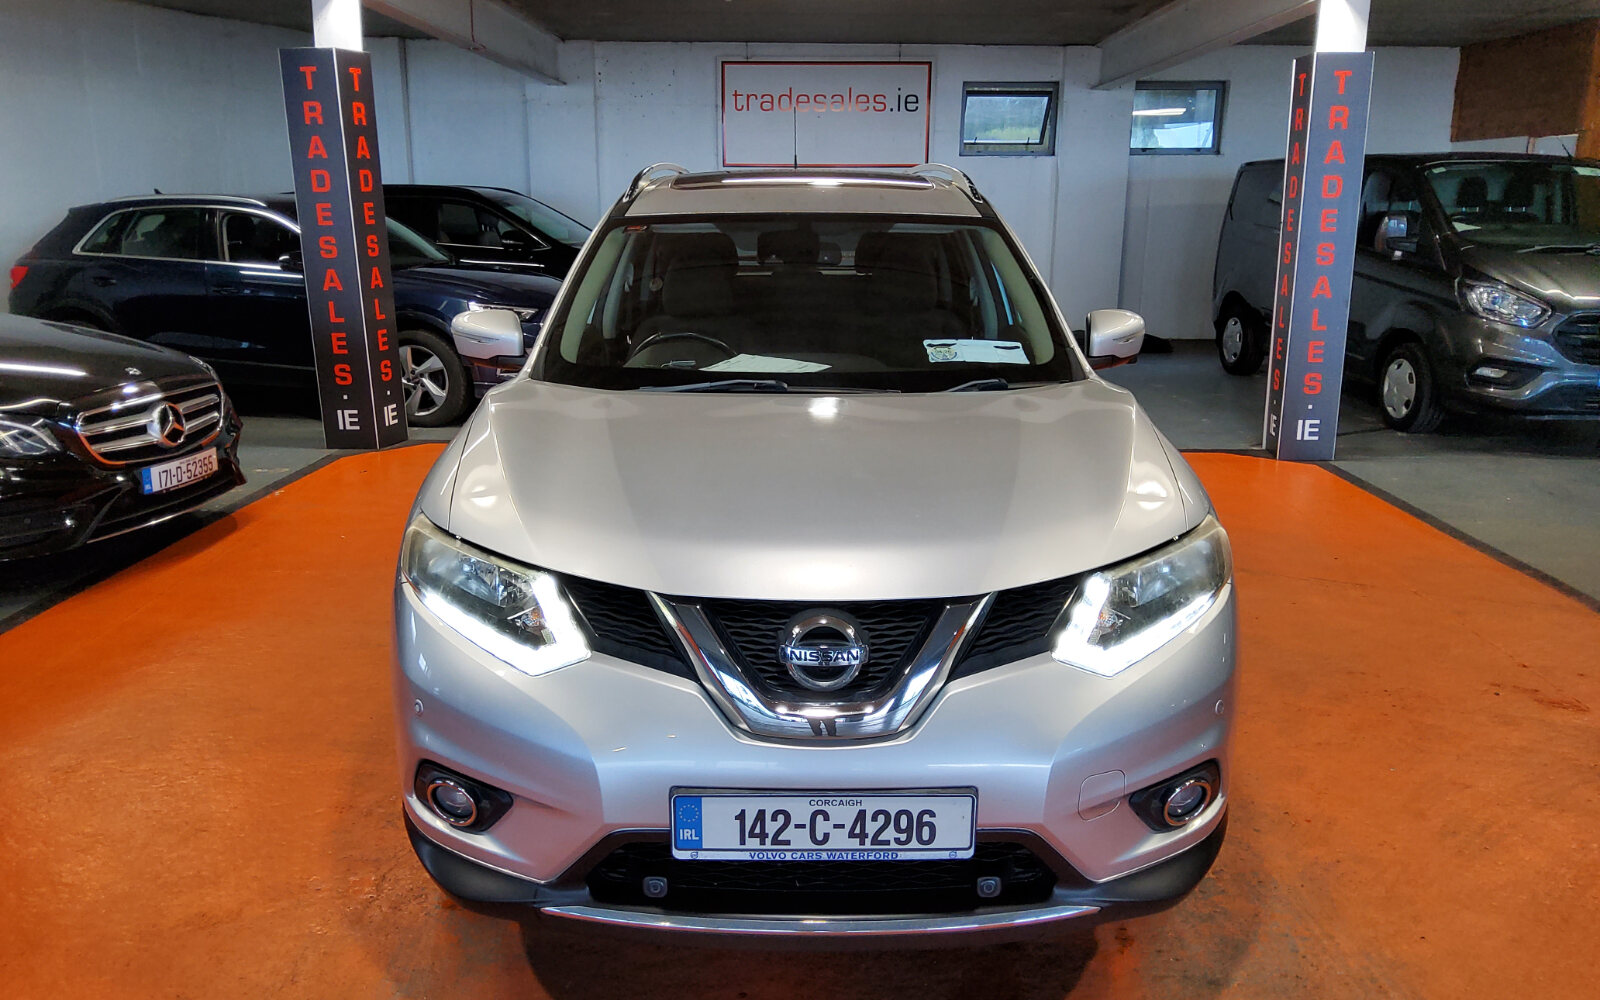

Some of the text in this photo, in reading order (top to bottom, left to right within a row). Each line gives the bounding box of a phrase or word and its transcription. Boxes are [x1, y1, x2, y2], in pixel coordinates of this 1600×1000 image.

[732, 87, 919, 113] tradesales.ie
[789, 650, 860, 662] NISSAN
[808, 799, 863, 807] CORCAIGH
[734, 808, 937, 847] 142-C-4296
[679, 828, 700, 840] IRL
[749, 851, 899, 860] VOLVO CARS WATERFORD
